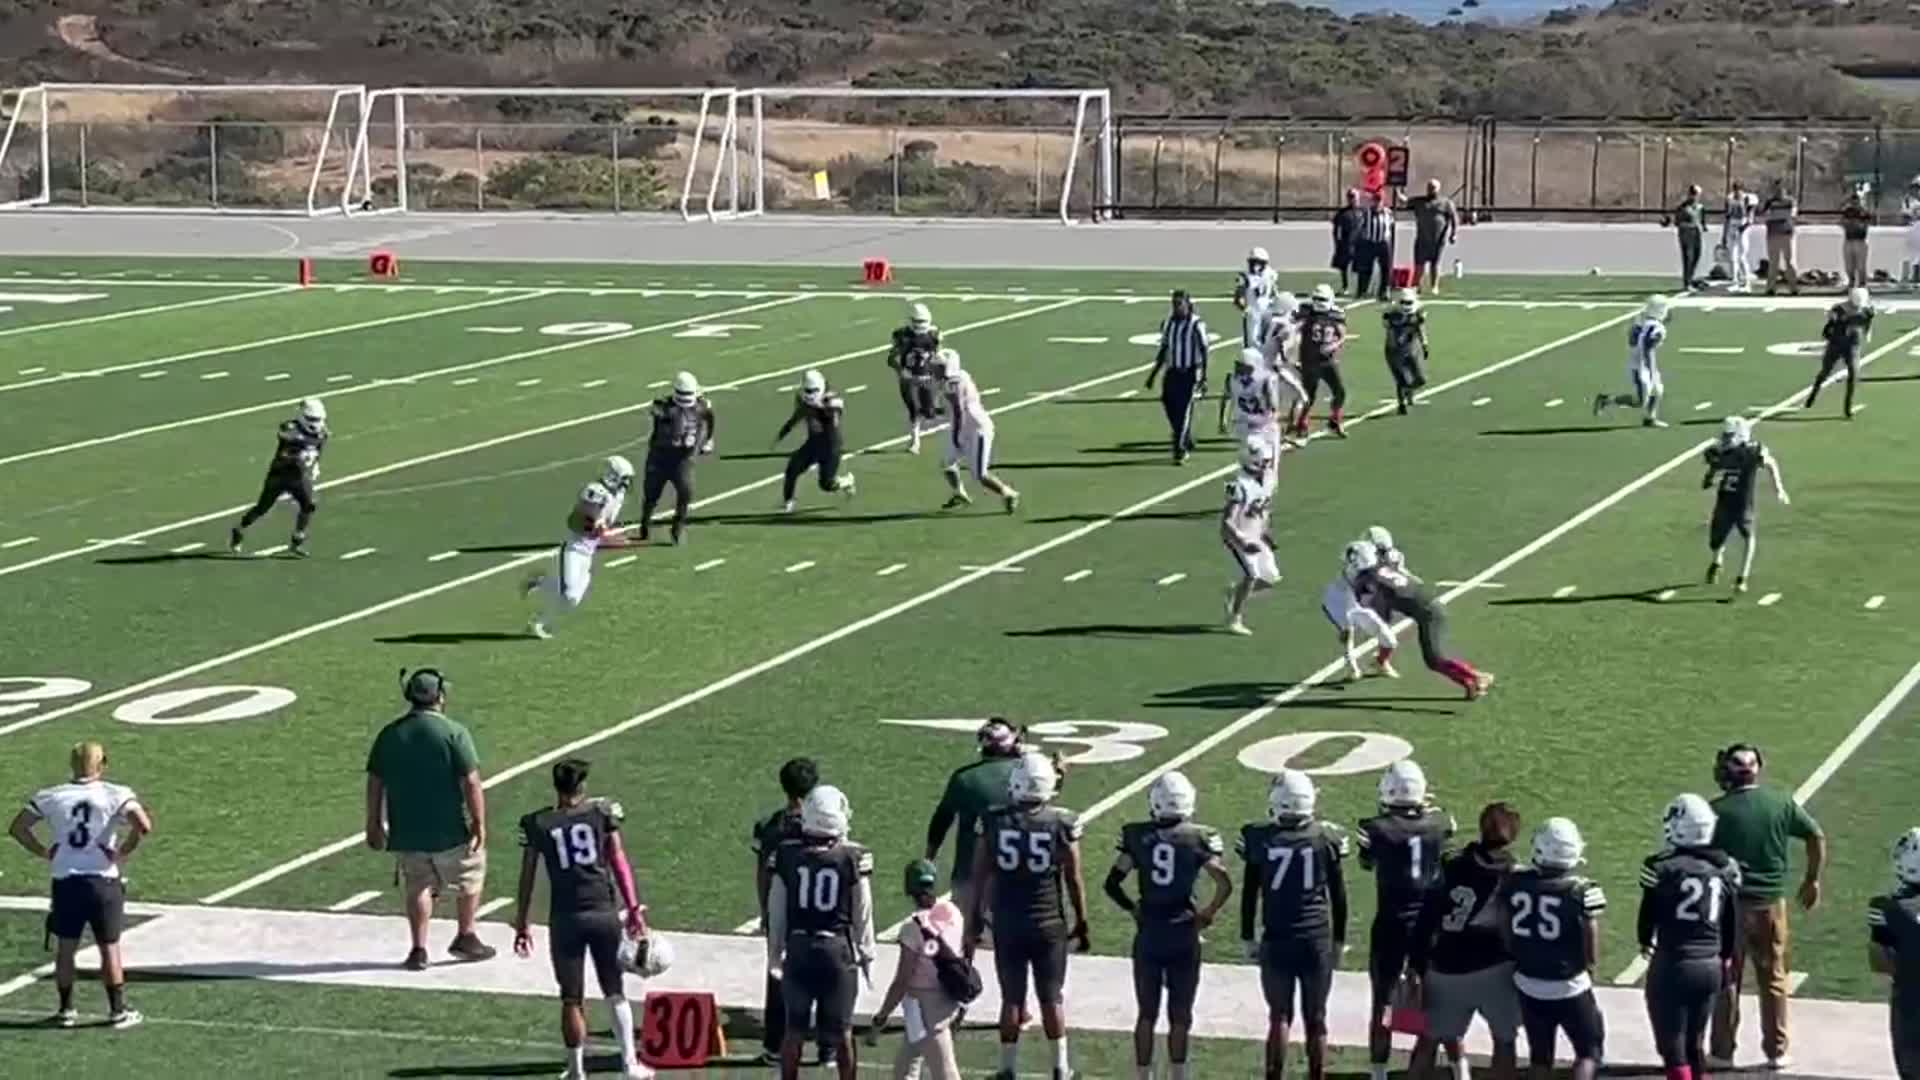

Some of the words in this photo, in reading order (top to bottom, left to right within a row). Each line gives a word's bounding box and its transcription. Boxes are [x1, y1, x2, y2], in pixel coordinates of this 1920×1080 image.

[68, 801, 92, 848] 3
[551, 823, 598, 869] 19
[997, 829, 1051, 872] 55
[1152, 843, 1175, 886] 9
[1267, 846, 1314, 890] 71
[1408, 836, 1421, 879] 1
[797, 866, 839, 912] 10
[1676, 876, 1723, 923] 21
[1511, 891, 1561, 940] 25
[644, 996, 700, 1060] 30
